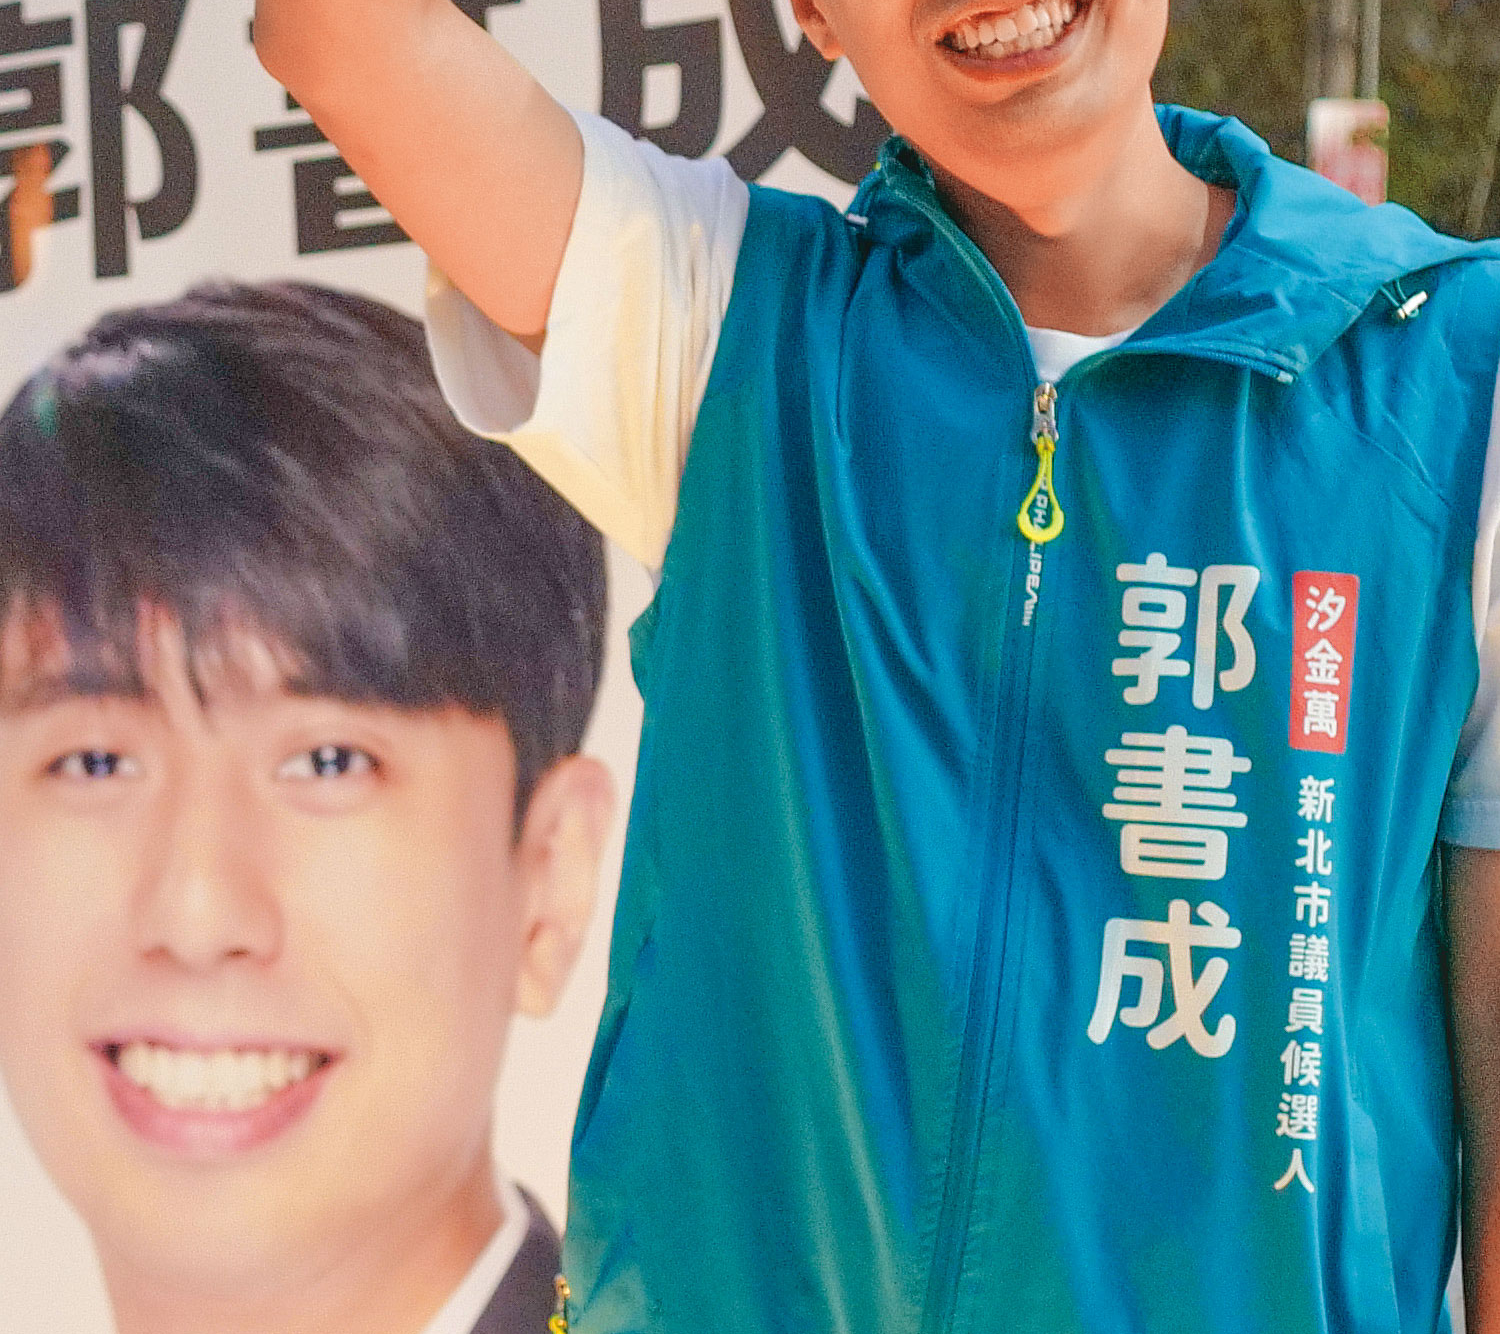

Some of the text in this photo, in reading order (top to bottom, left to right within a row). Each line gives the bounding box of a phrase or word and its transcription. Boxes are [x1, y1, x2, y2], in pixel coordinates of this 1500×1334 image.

[1087, 551, 1261, 1058] 郭書成
[1302, 584, 1348, 739] 汐金萬
[1273, 774, 1336, 1195] 新北市議員候選人
